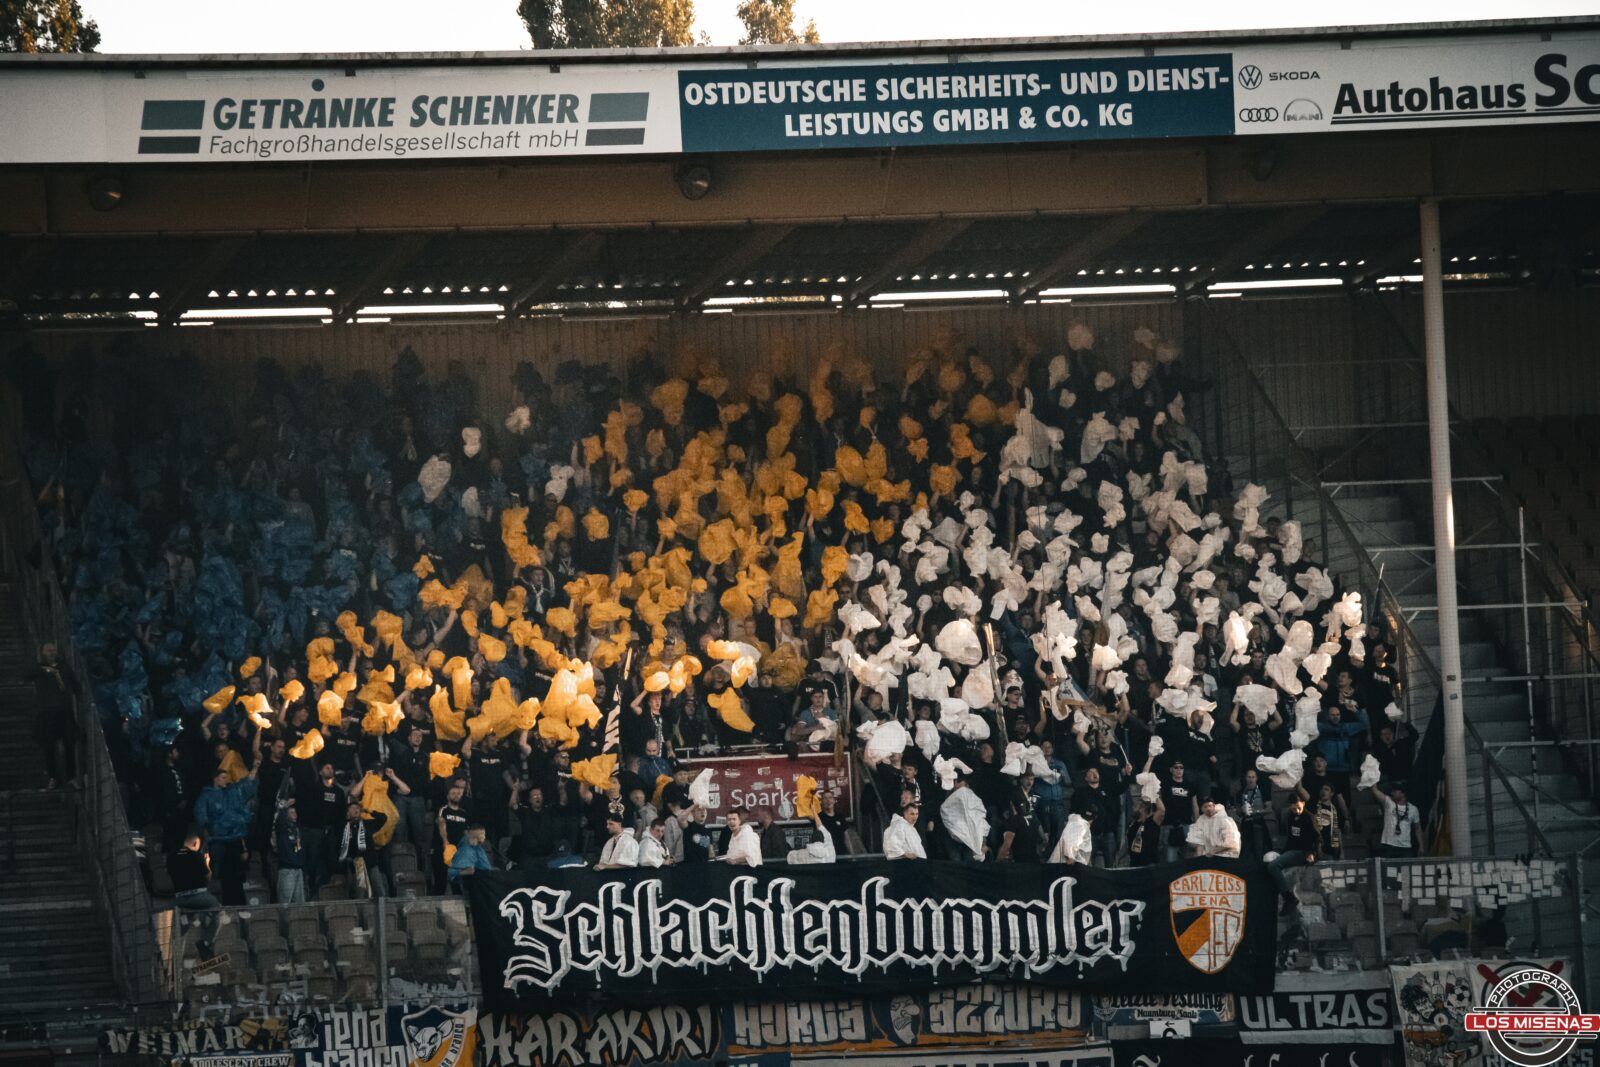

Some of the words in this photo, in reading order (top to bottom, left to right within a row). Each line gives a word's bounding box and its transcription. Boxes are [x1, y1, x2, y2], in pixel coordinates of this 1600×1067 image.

[685, 77, 867, 106] OSTDEUTSCHE
[877, 72, 1052, 102] SICHERHEITS-
[1061, 70, 1118, 96] UND
[1128, 67, 1230, 93] DIENST-
[1333, 76, 1527, 115] Autohaus
[410, 93, 580, 128] SCHENKER
[785, 109, 924, 137] LEISTUNGS
[933, 107, 1009, 132] GMBH
[1019, 106, 1037, 130] &
[1046, 105, 1089, 129] CO.
[1099, 103, 1134, 127] KG
[209, 130, 521, 158] Fachgroßhandelsgesellschaft
[528, 129, 579, 149] mbH
[1186, 895, 1231, 908] JENA
[498, 875, 1147, 990] Schlachtenbummler
[1239, 992, 1389, 1029] ULTRAS
[104, 1026, 247, 1055] WEIMAR
[478, 1003, 713, 1067] HARAKIRI
